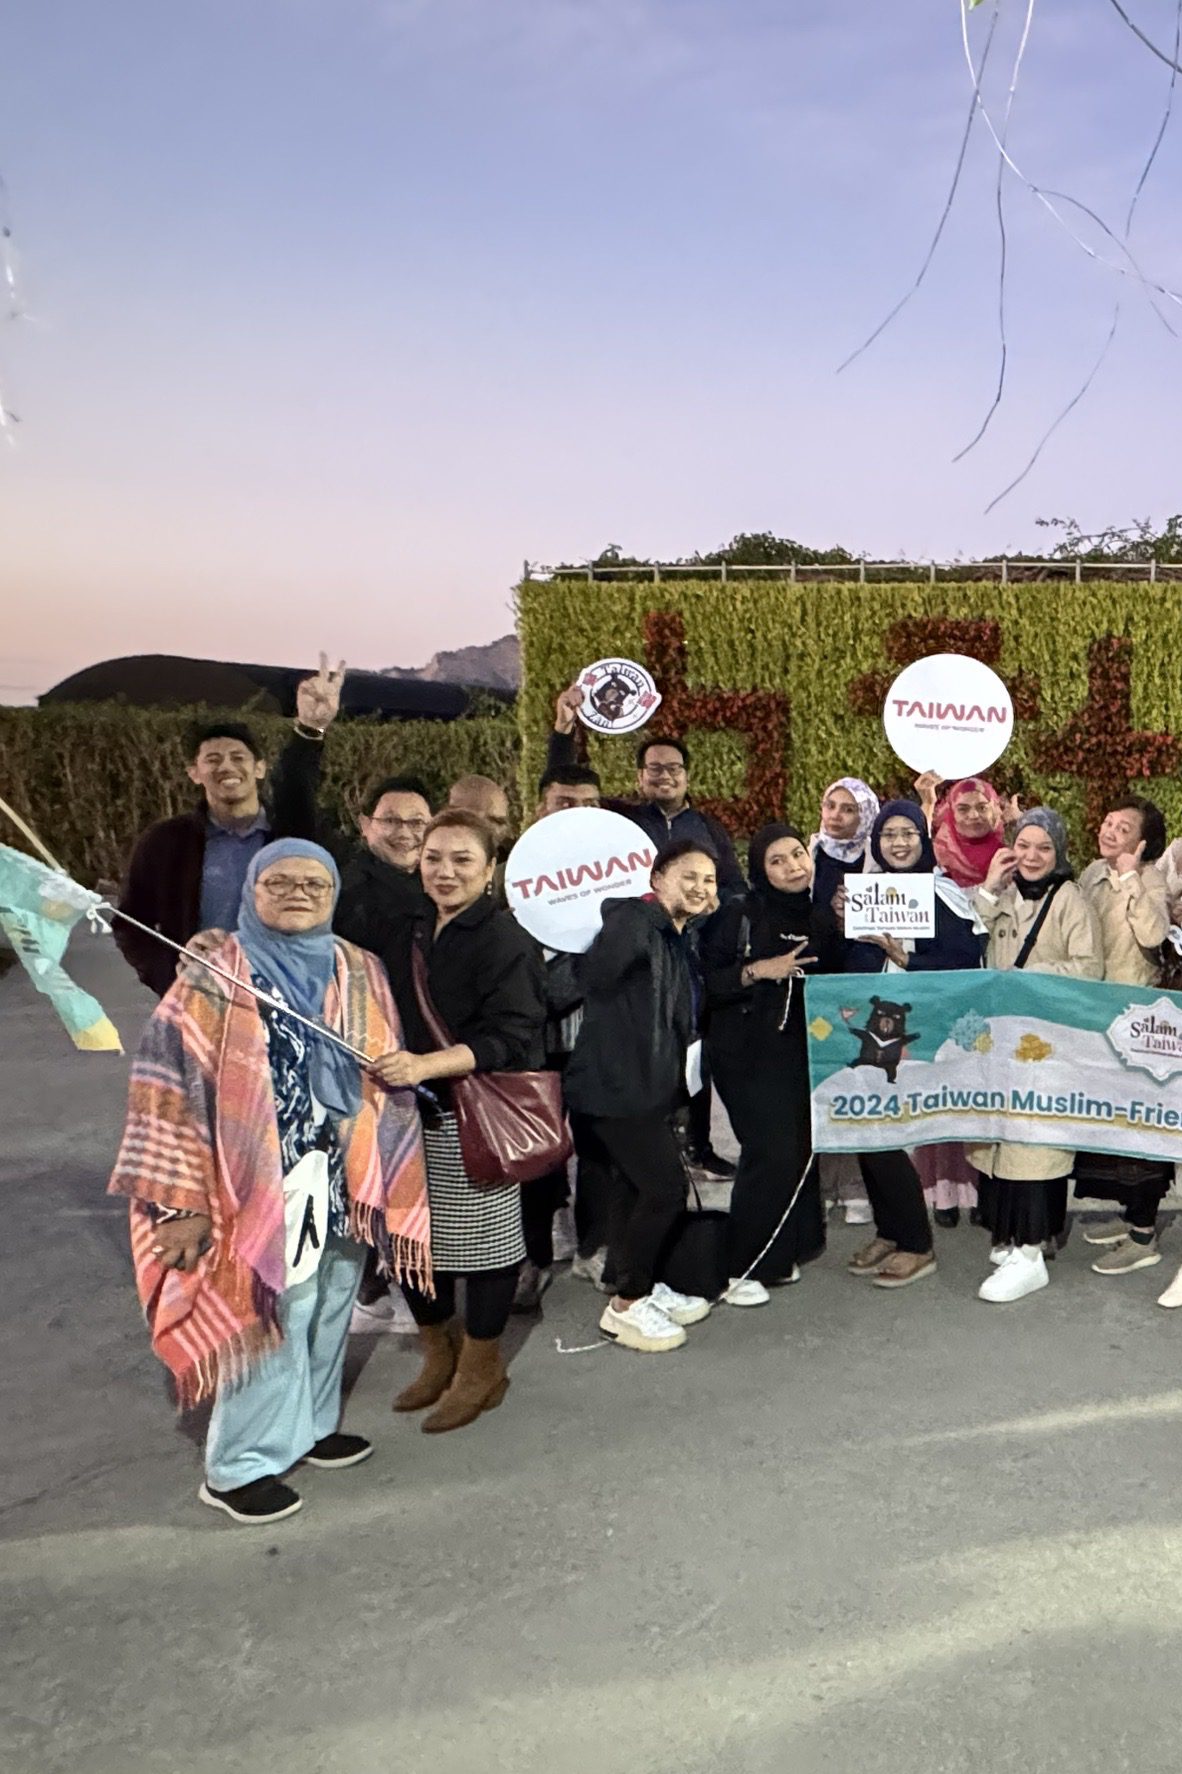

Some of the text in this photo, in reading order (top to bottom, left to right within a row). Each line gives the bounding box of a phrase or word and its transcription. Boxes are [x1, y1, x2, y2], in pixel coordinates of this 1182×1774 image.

[892, 699, 1007, 723] TAIWAN
[512, 848, 652, 899] TAIWAN
[580, 889, 592, 898] OF
[851, 882, 906, 912] Salam
[865, 907, 930, 923] Taiwan
[1130, 1015, 1177, 1038] Salam
[833, 1094, 900, 1116] 2024
[907, 1086, 1004, 1113] Taiwan
